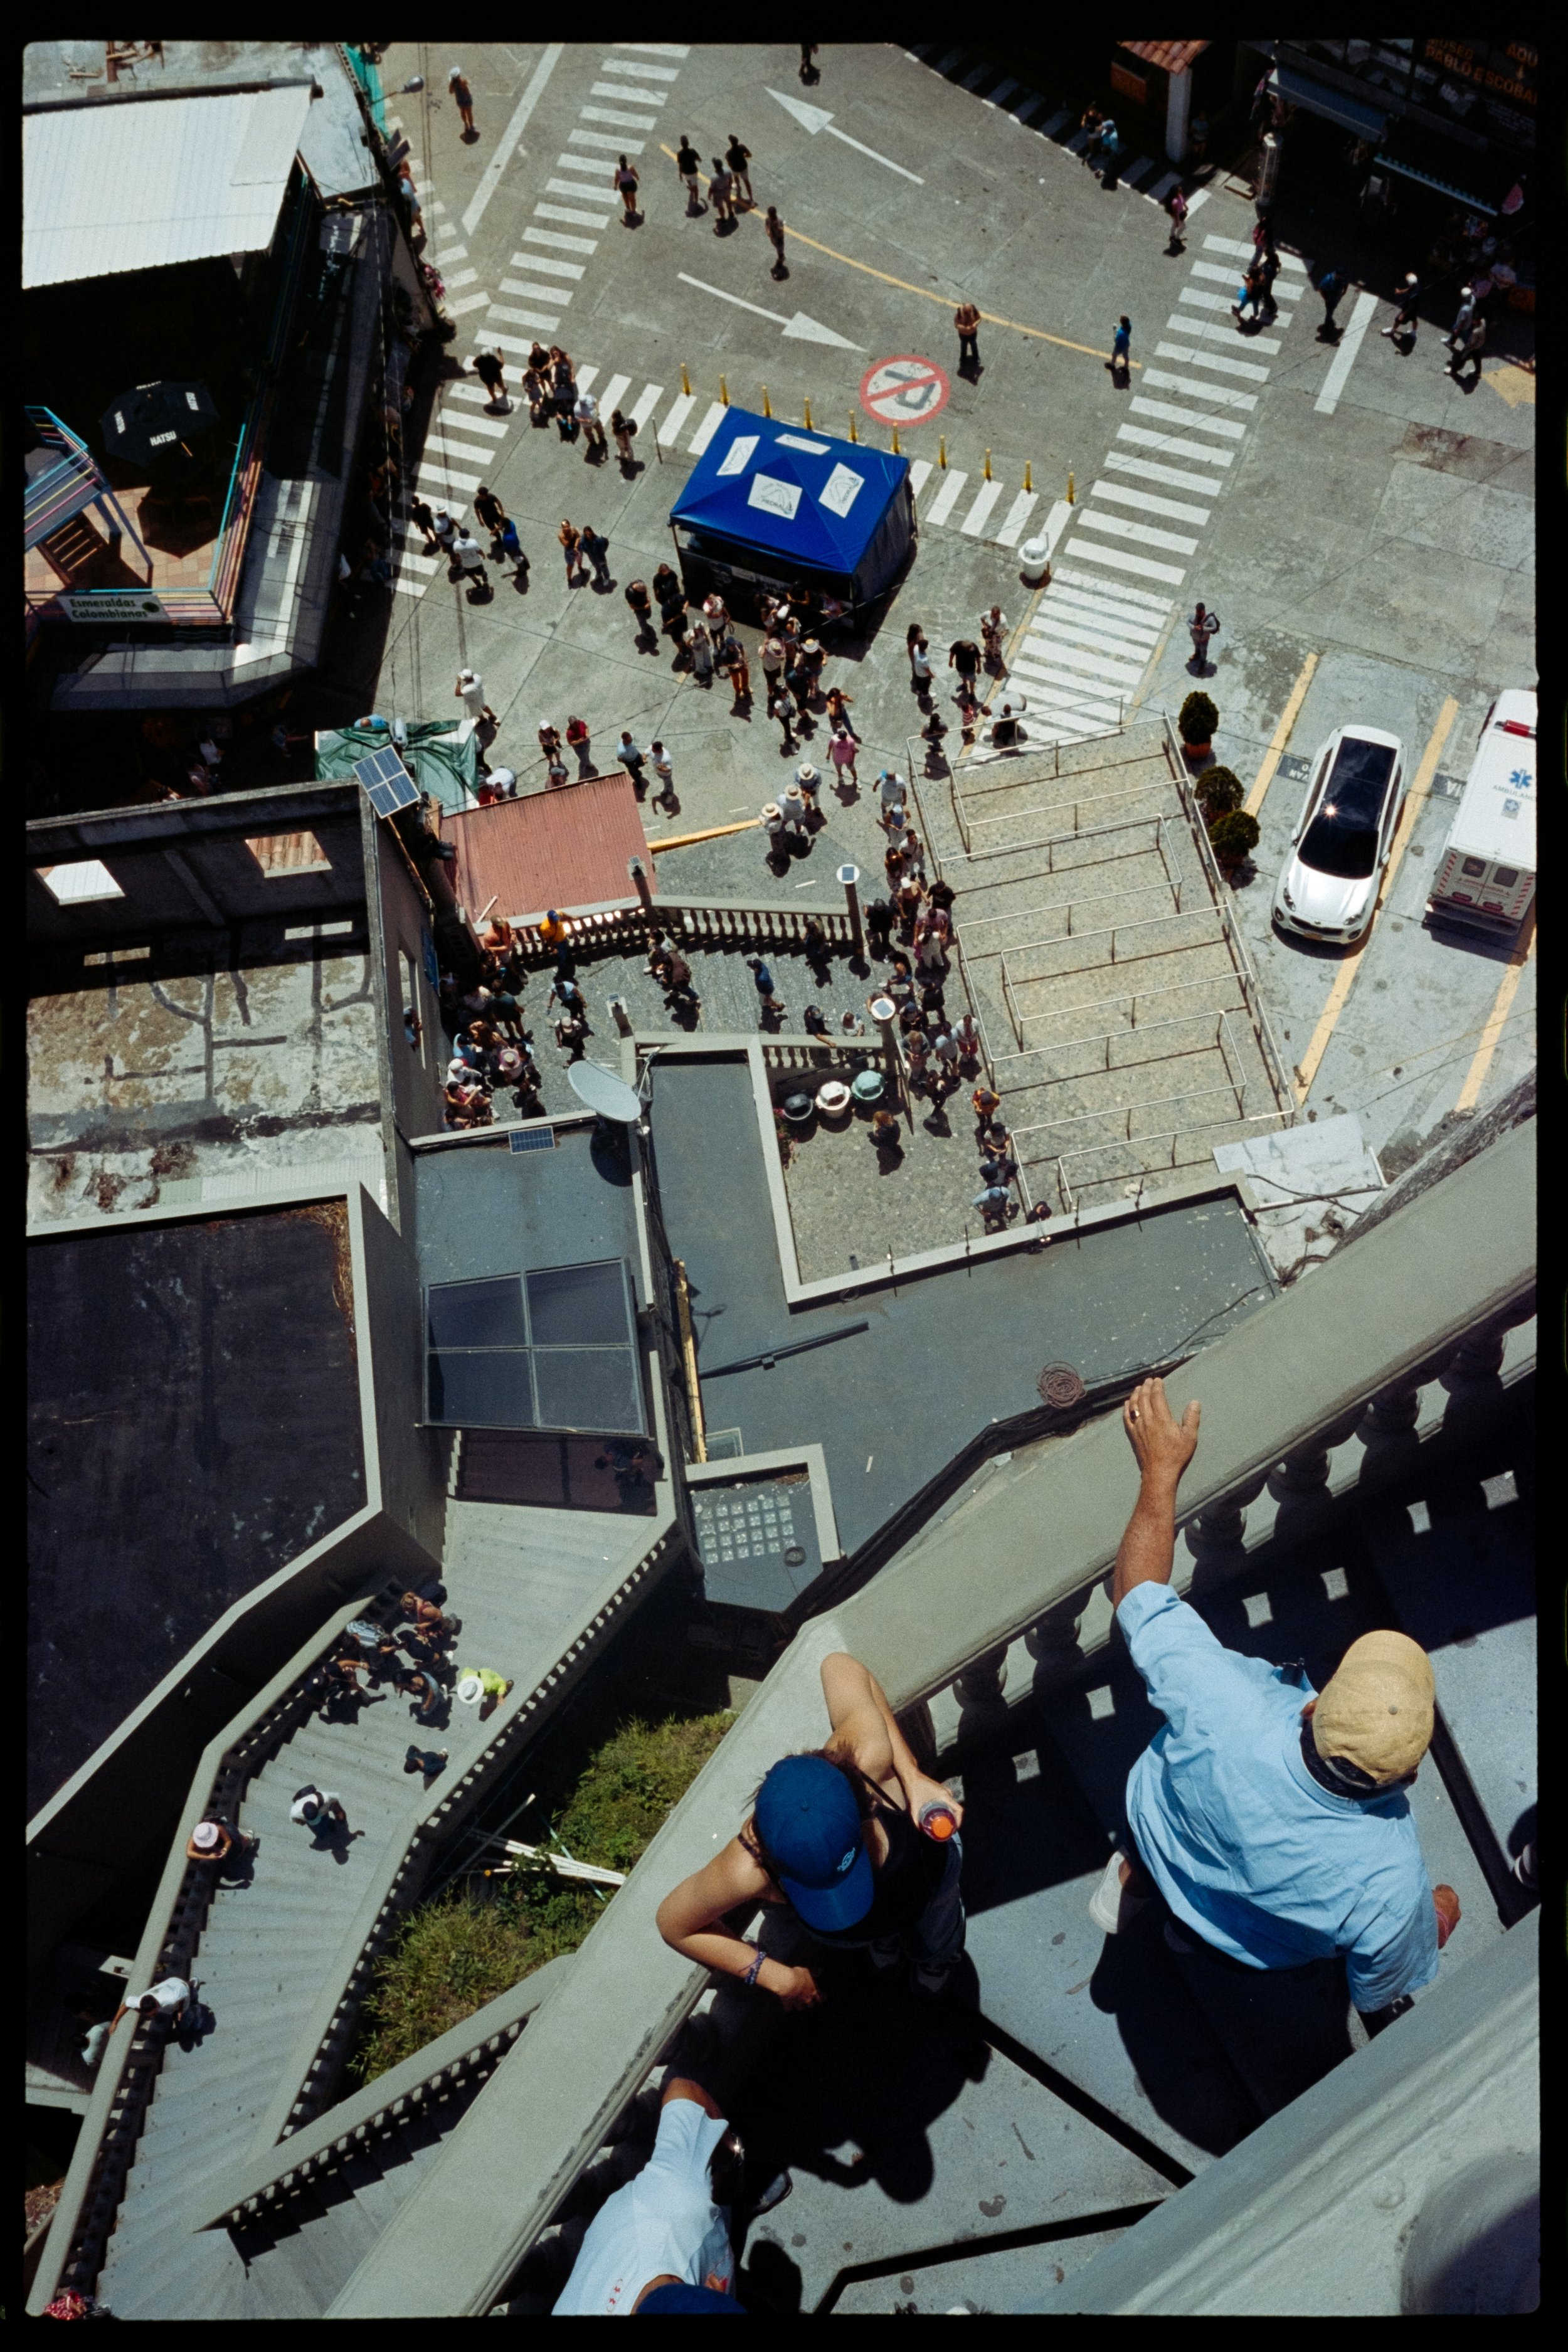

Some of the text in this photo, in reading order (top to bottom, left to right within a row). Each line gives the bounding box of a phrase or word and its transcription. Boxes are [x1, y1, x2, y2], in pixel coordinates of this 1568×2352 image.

[1425, 45, 1472, 76] PABLO
[149, 430, 177, 446] HATSU
[69, 597, 136, 607] Esmeraldas
[72, 609, 148, 618] Colombianas
